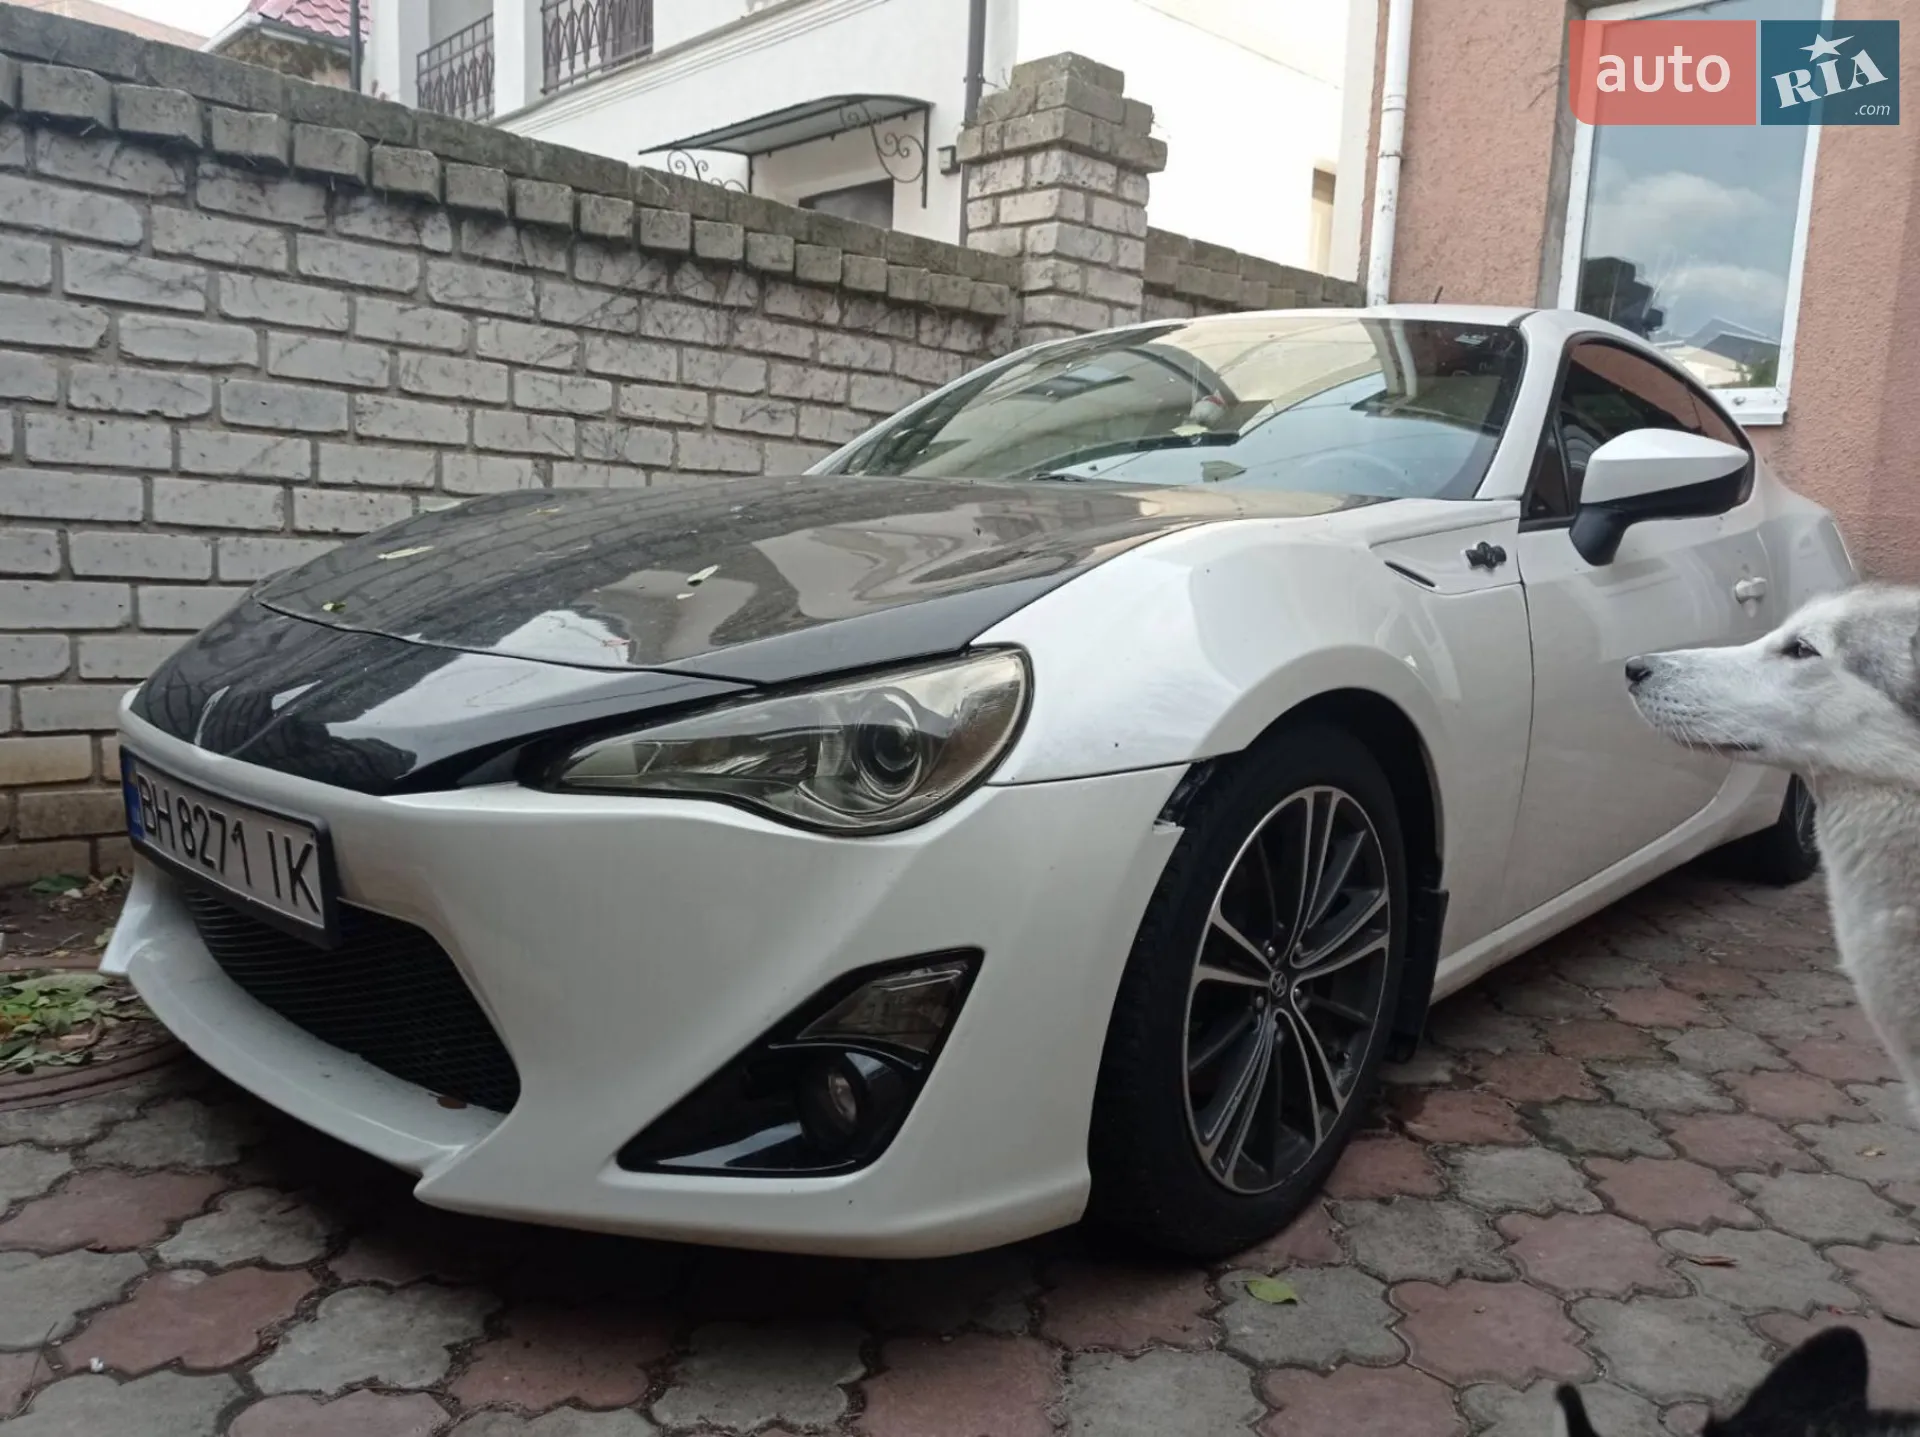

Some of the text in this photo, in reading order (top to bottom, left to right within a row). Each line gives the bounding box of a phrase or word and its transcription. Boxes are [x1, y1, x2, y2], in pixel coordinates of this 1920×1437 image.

[137, 773, 320, 916] BH 8271 IK
